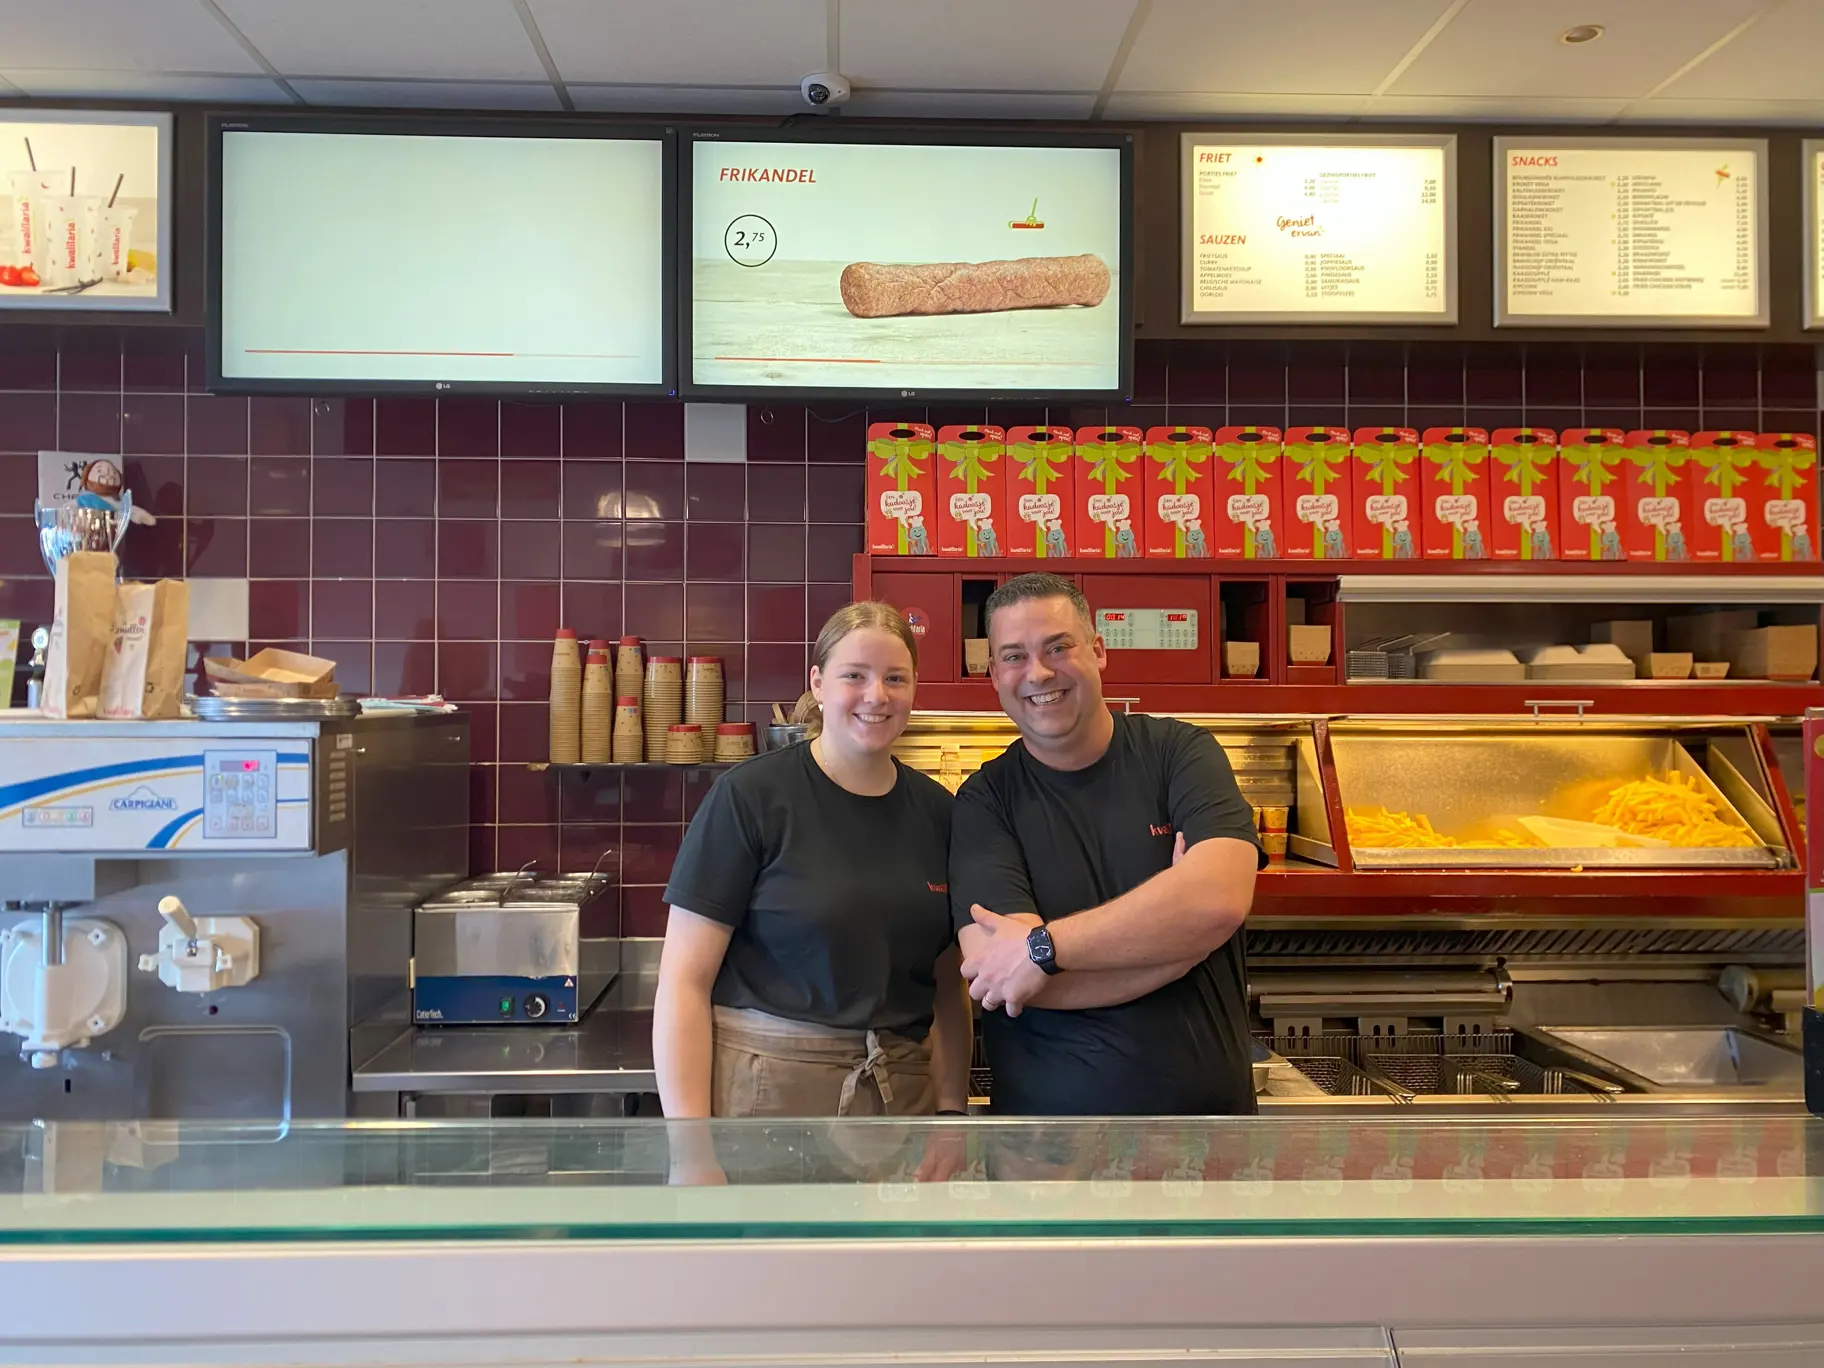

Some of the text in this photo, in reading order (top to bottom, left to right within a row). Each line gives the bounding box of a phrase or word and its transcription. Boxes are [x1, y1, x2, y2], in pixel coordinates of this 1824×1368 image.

[1200, 153, 1232, 163] FRIET
[1512, 156, 1558, 166] SNACKS
[720, 168, 816, 183] FRIKANDEL
[1277, 215, 1314, 231] Geniet
[1200, 234, 1246, 245] SAUZEN
[884, 498, 916, 508] kadoosje
[954, 501, 985, 511] kadoosje
[1023, 502, 1054, 511] kadoosje
[1093, 502, 1124, 511] kadoosje
[1162, 502, 1194, 511] kadoosje
[904, 505, 916, 515] jou!
[973, 507, 985, 517] jou!
[1042, 508, 1054, 518] jou!
[1112, 508, 1124, 518] jou!
[113, 800, 173, 809] CARPIGIANI
